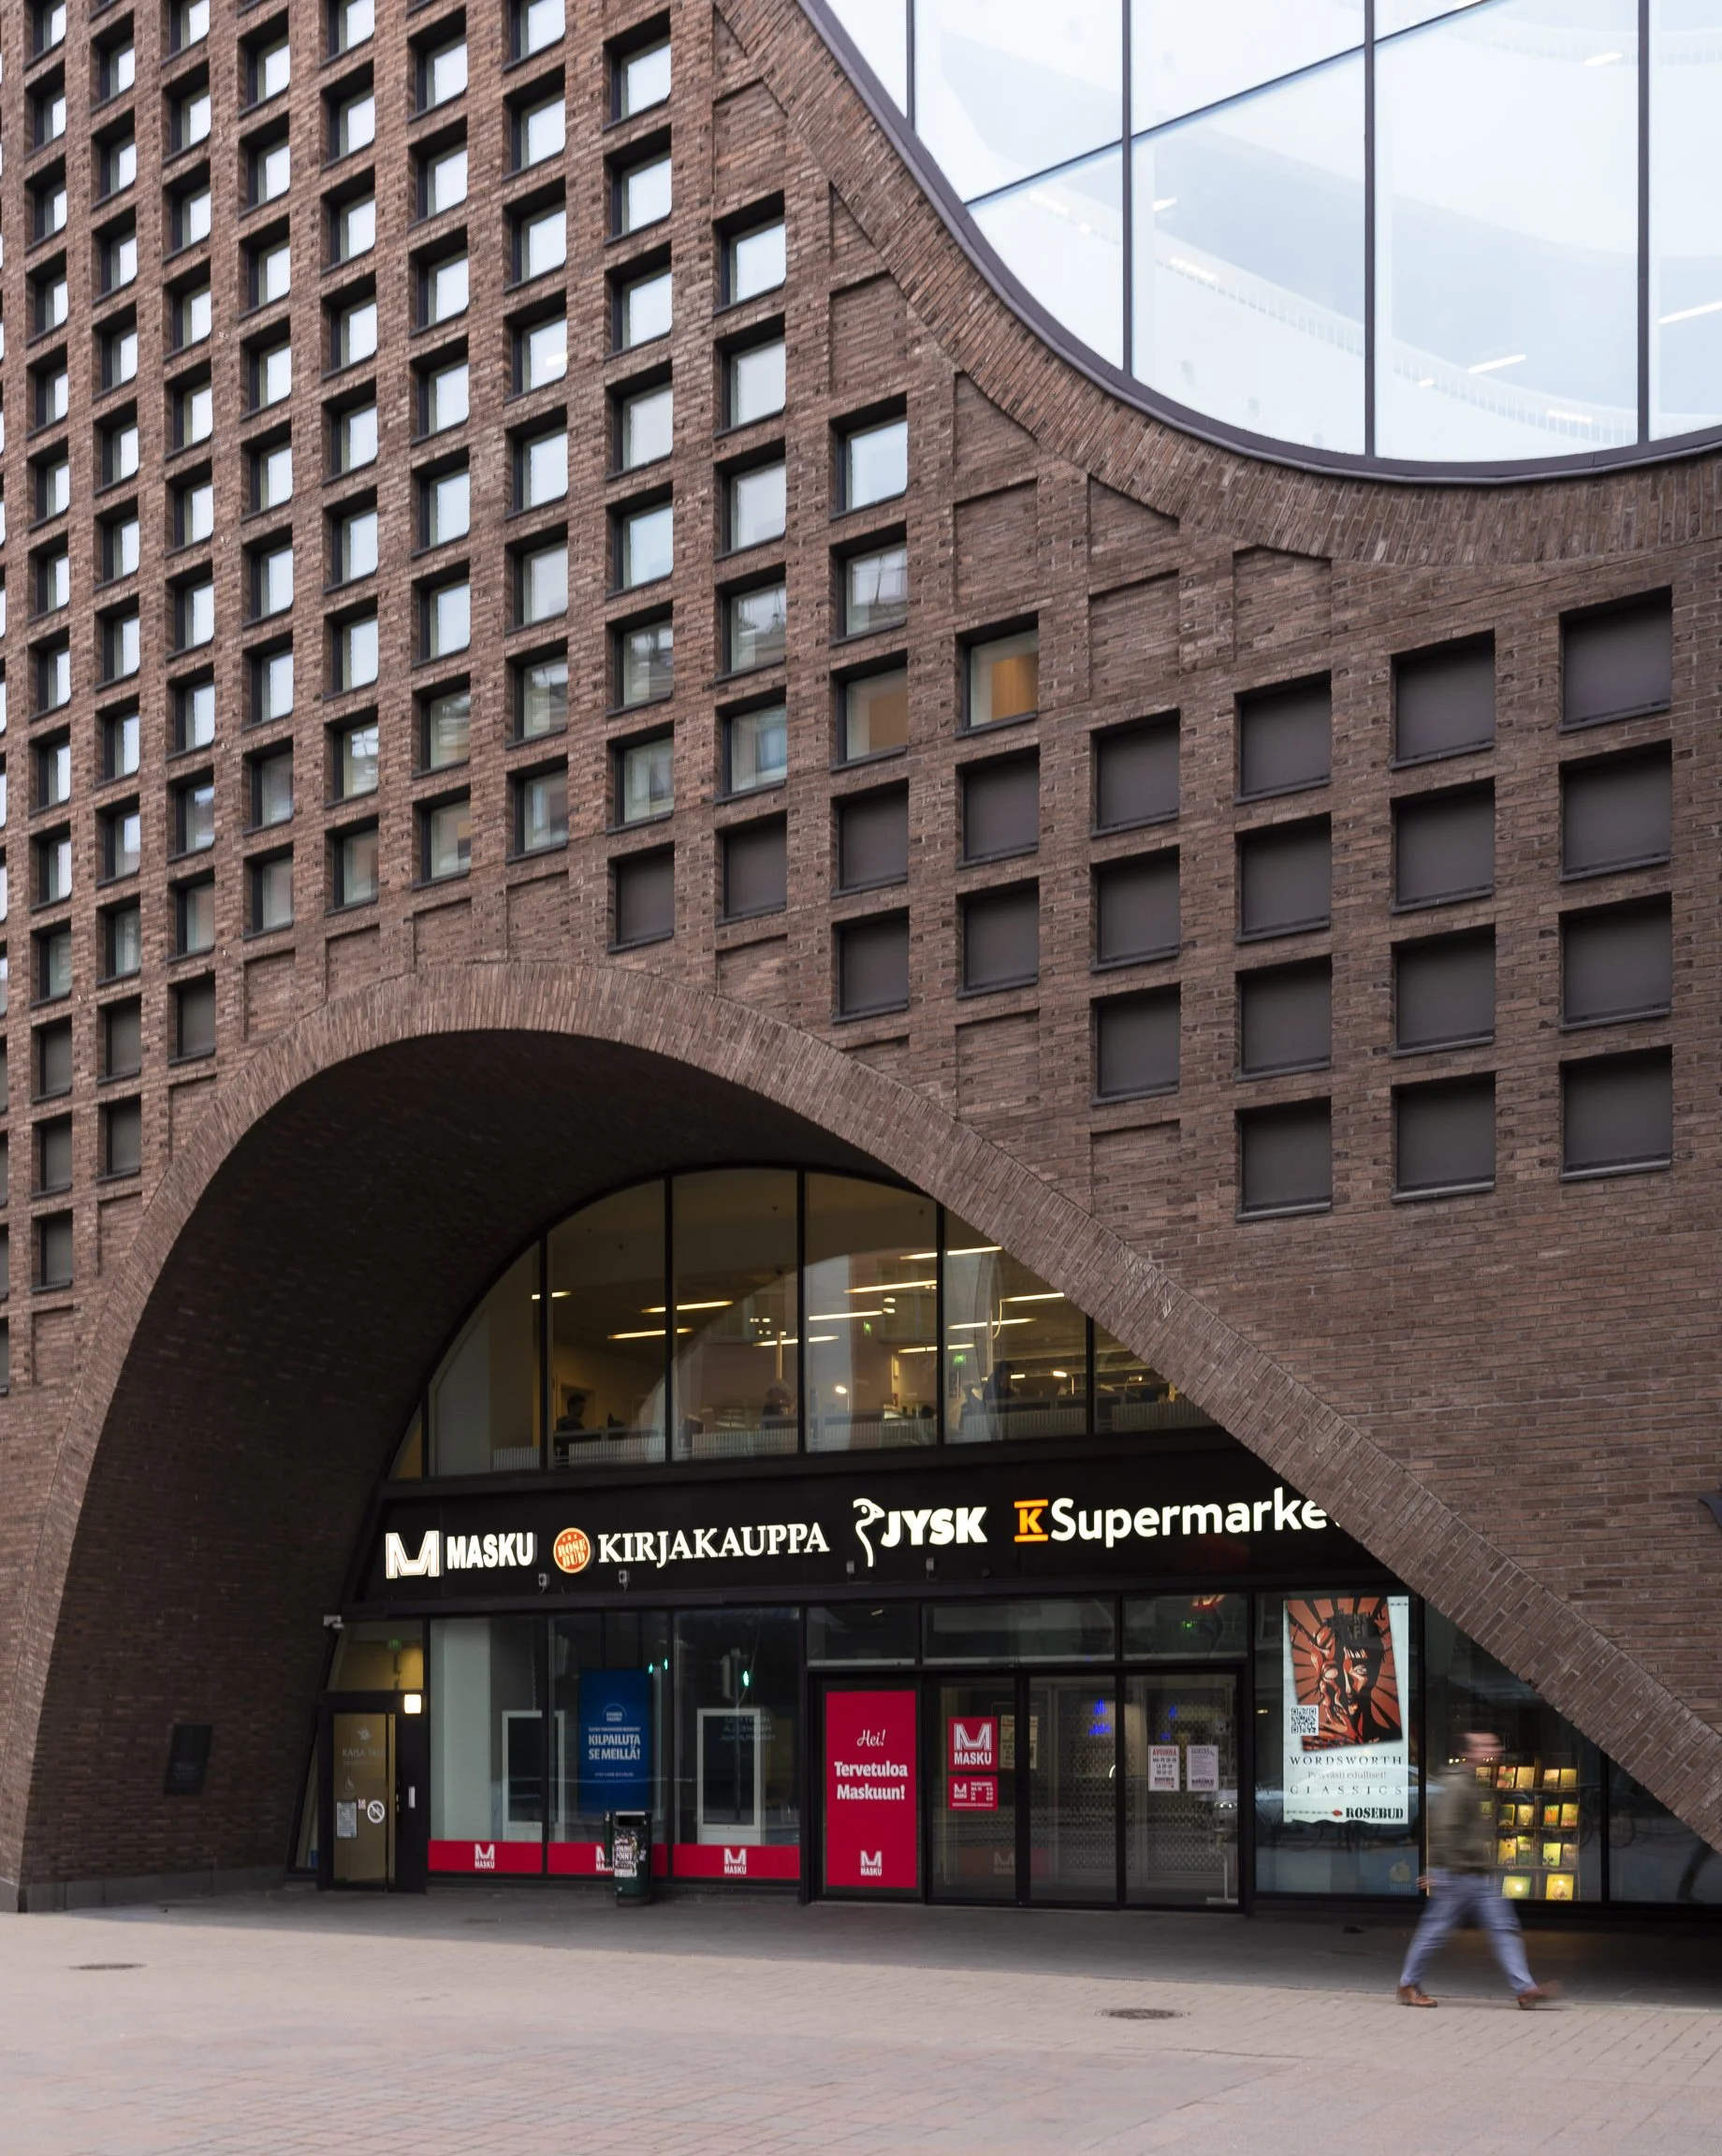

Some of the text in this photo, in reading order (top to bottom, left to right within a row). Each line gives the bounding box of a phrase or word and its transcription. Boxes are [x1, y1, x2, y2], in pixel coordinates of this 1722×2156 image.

[1050, 1487, 1340, 1548] Supermarke
[881, 1507, 988, 1548] JYSK
[446, 1532, 534, 1569] MASKU
[557, 1537, 587, 1558] ROSE
[598, 1522, 830, 1568] KIRJAKAUPPA
[562, 1551, 586, 1567] BUD
[588, 1734, 641, 1745] KILPAILUTA
[856, 1728, 886, 1747] Hei!
[588, 1744, 641, 1760] SE MEILLÄ!
[954, 1751, 992, 1766] MASKU
[834, 1760, 909, 1778] Tervetuloa
[1290, 1756, 1402, 1766] WORDSWORTH
[1347, 1770, 1386, 1780] edulliset!
[837, 1784, 905, 1800] Maskuun!
[1346, 1807, 1404, 1819] ROSEBUD
[474, 1859, 495, 1870] MASKU
[723, 1864, 747, 1875] MASKU
[860, 1866, 883, 1876] MASKU
